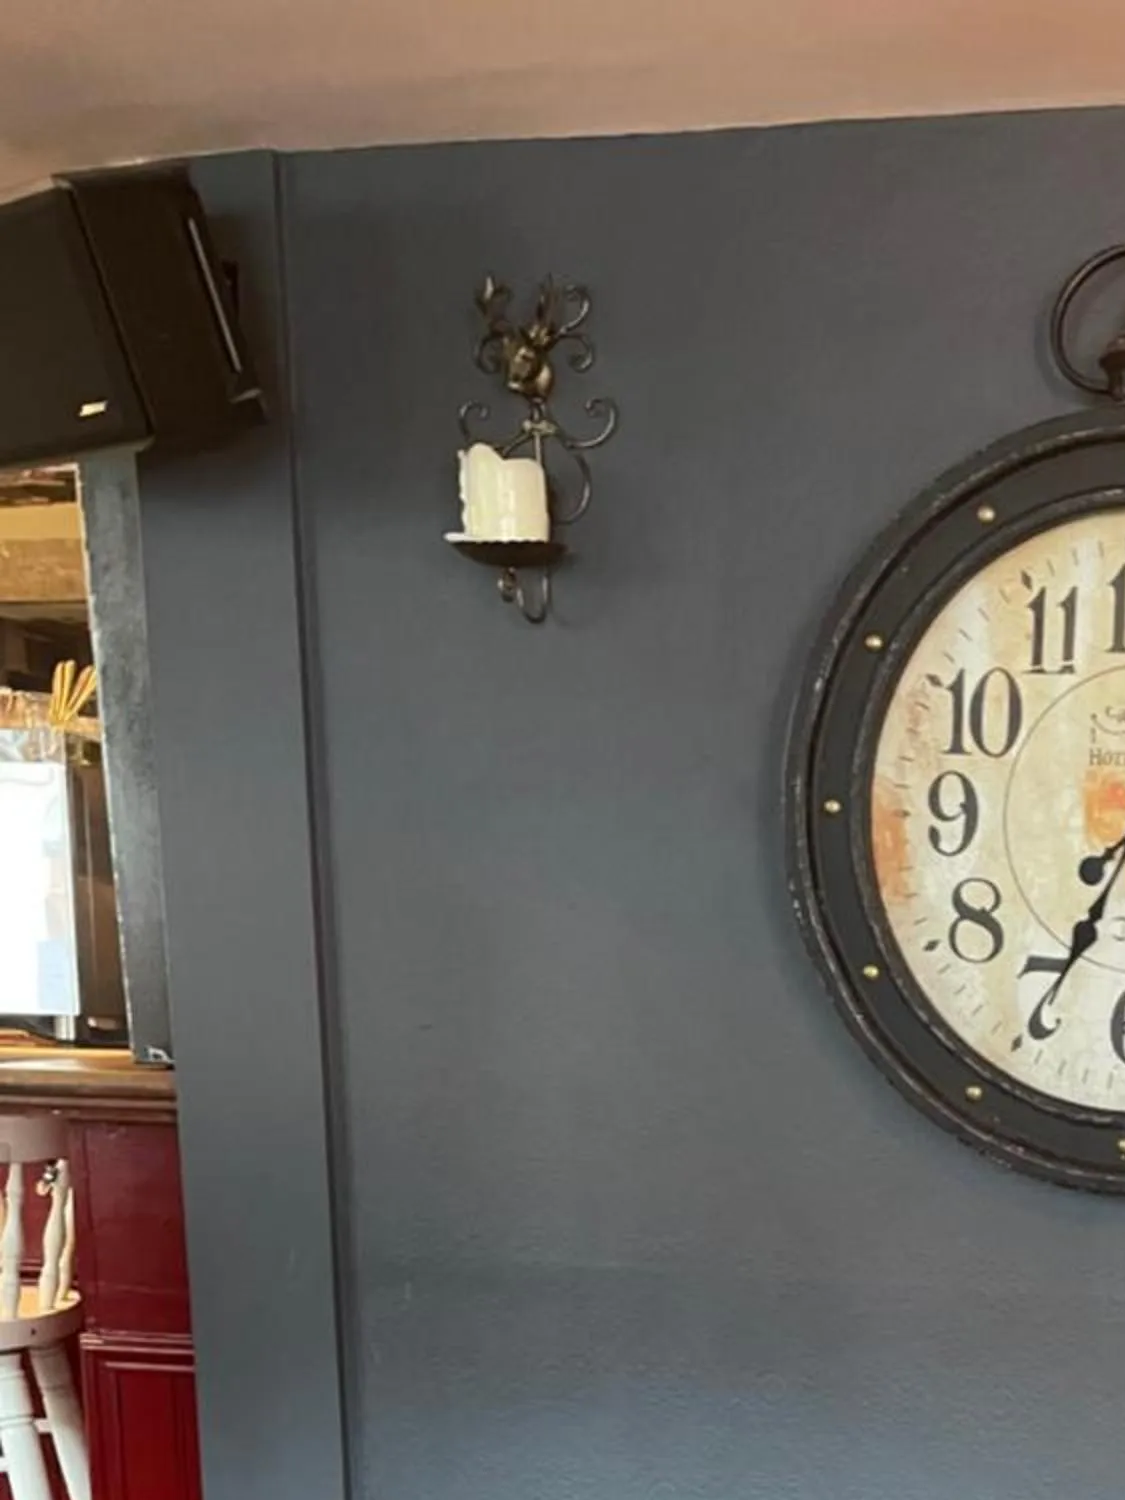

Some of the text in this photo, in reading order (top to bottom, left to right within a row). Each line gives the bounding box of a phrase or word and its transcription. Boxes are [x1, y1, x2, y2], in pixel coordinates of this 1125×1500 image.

[1025, 586, 1079, 675] 11
[942, 667, 1023, 759] 10
[927, 770, 979, 857] 9
[947, 877, 1003, 964] 8
[1016, 953, 1076, 1041] 7
